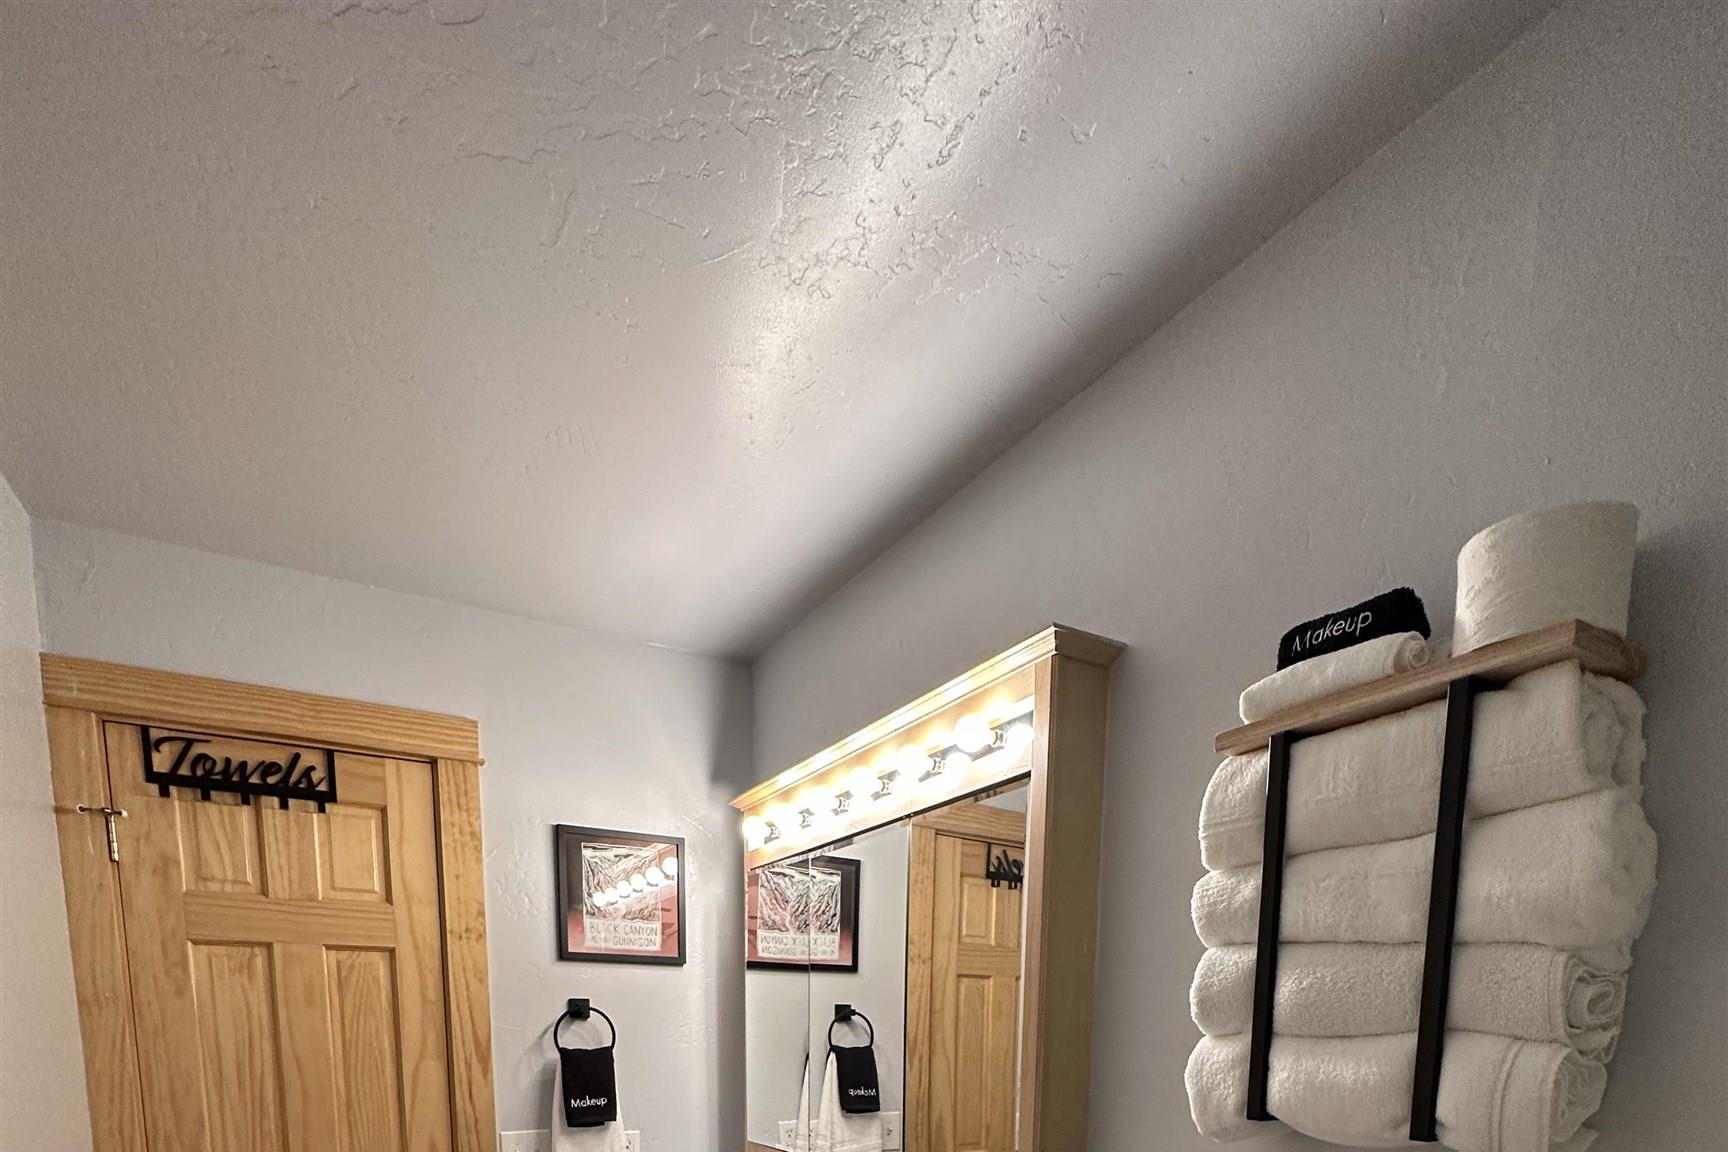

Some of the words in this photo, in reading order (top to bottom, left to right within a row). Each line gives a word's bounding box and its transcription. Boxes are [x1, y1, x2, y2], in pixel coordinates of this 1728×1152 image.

[1291, 611, 1372, 657] Makeup
[153, 736, 327, 792] Towels
[623, 924, 658, 937] CANYON
[571, 1095, 608, 1108] Makeup
